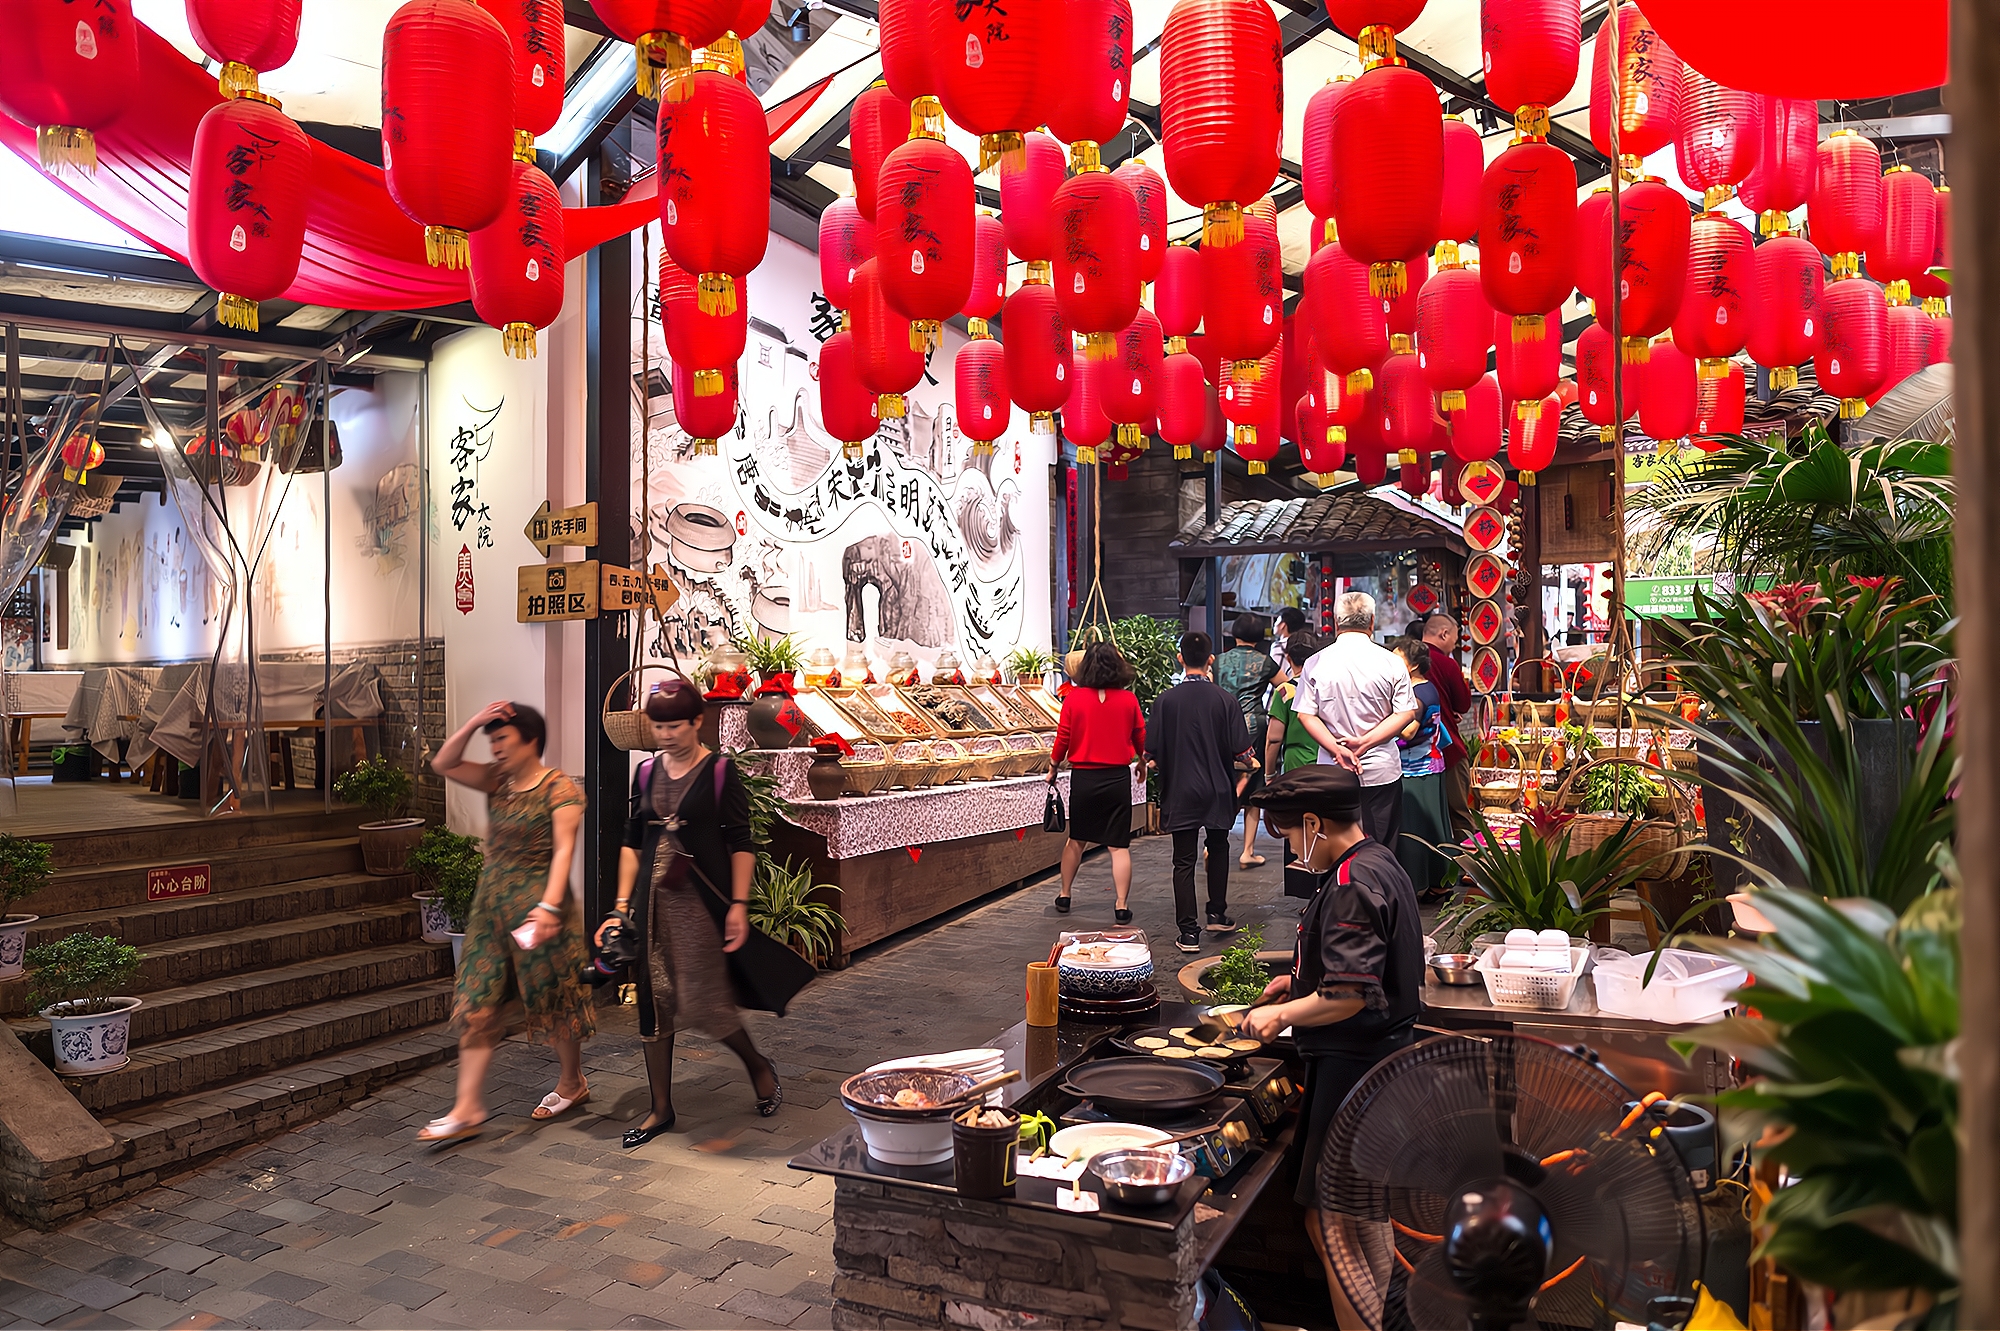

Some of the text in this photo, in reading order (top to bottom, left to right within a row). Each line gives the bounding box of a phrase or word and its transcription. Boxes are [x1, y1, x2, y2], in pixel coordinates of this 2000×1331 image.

[450, 426, 476, 531] 客家
[477, 502, 494, 549] 大院
[551, 517, 587, 536] 洗手间
[527, 593, 586, 616] 拍照区
[151, 873, 207, 895] 小心台阶
